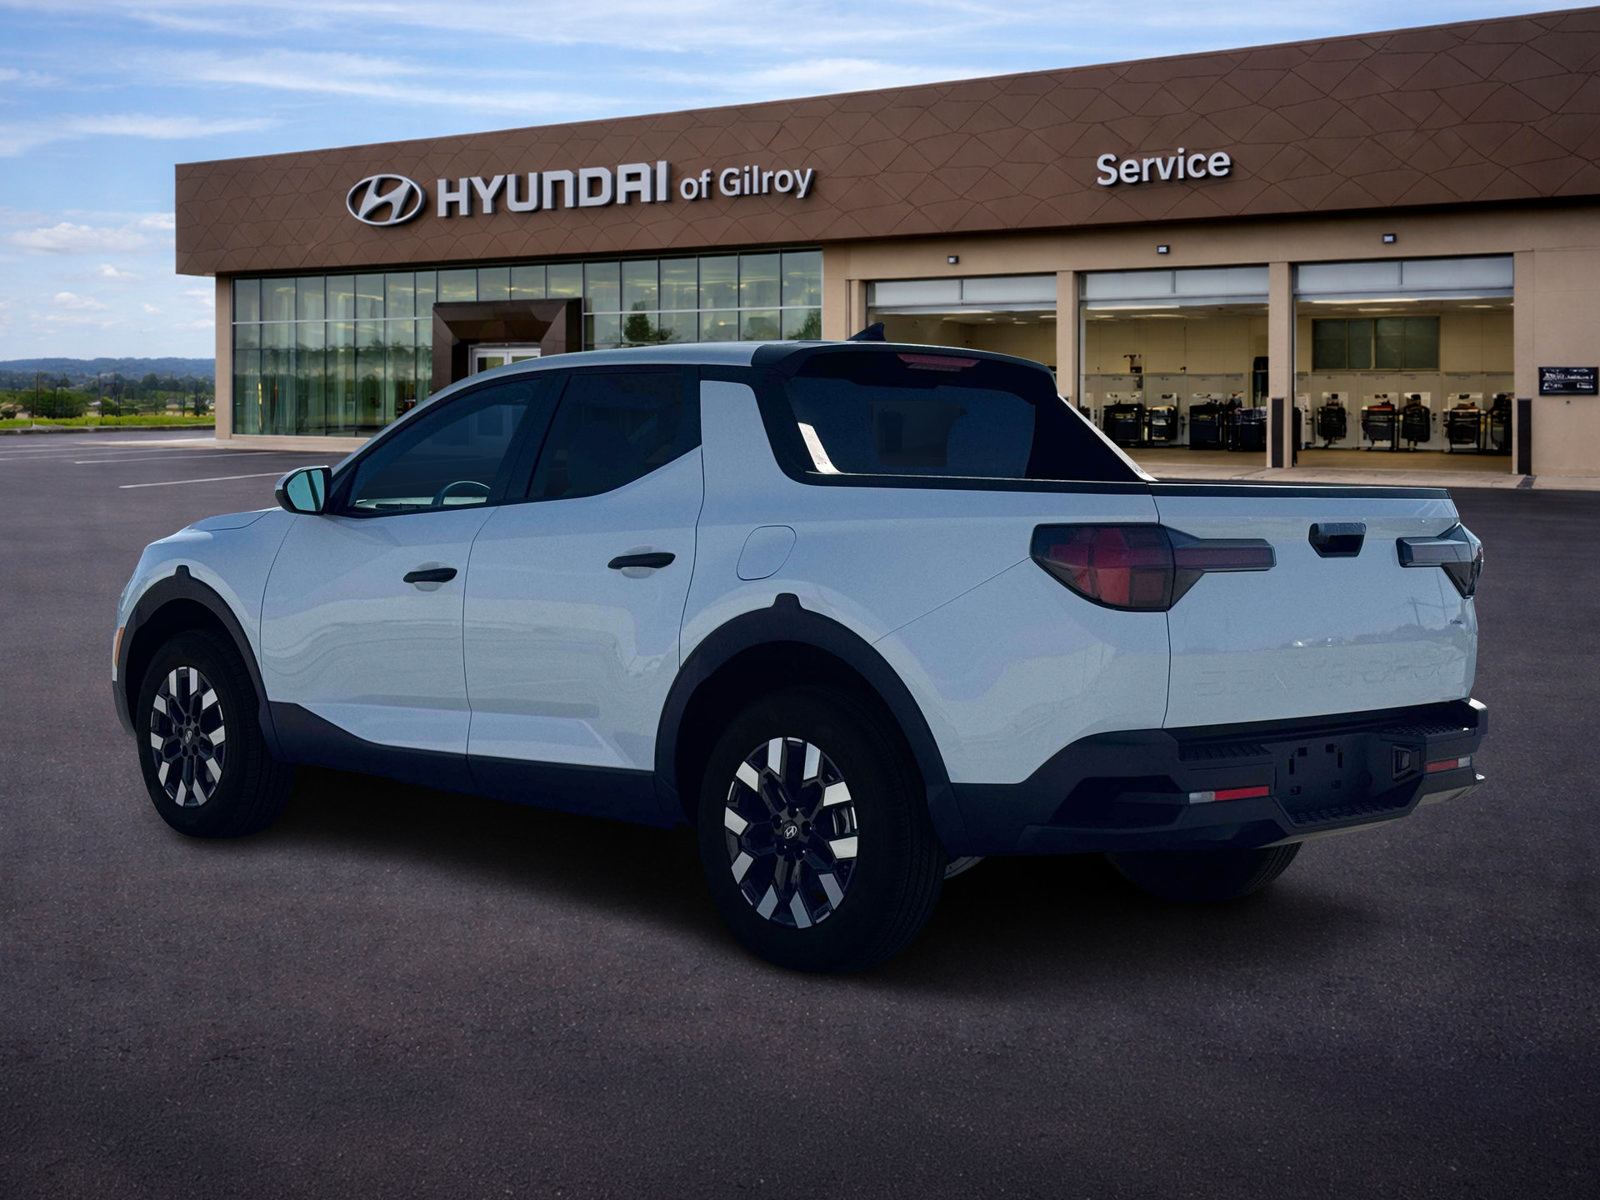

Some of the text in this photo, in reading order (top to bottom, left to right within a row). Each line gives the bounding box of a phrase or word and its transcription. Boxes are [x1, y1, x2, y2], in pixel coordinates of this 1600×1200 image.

[437, 160, 813, 217] HYUNDAI of Gilroy
[1096, 147, 1231, 186] Service
